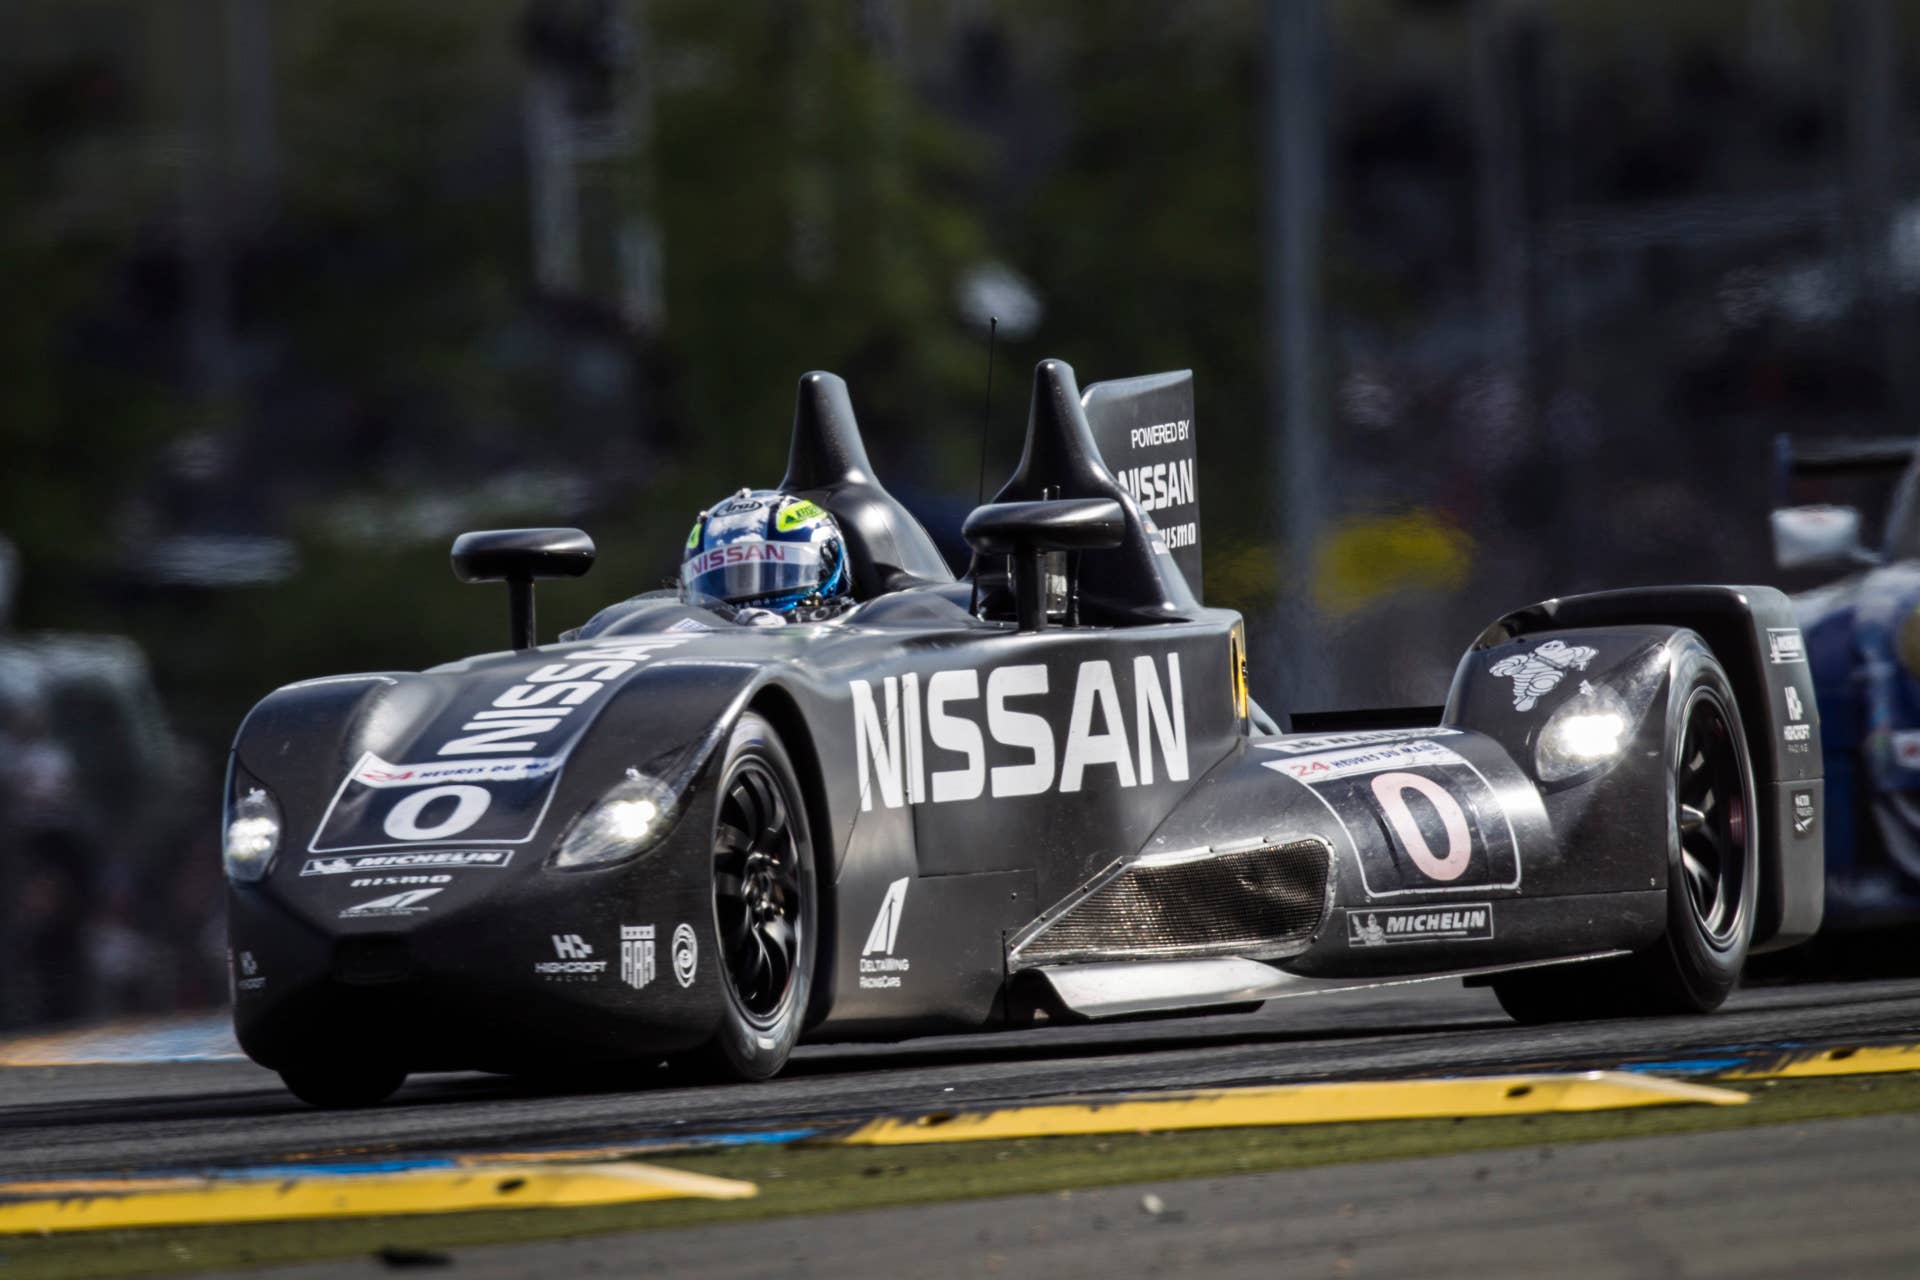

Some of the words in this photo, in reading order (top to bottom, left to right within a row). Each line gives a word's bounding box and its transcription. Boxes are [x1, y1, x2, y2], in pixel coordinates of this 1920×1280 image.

[1130, 422, 1177, 448] POWERED
[1177, 419, 1190, 440] BY
[1118, 457, 1194, 512] NISSAN
[691, 544, 785, 575] NISSAN
[849, 652, 1190, 811] NISSAN
[1290, 761, 1331, 777] 24
[383, 784, 492, 840] 0
[1371, 772, 1472, 881] 0
[355, 852, 502, 867] MICHELIN
[1386, 910, 1486, 933] MICHELIN
